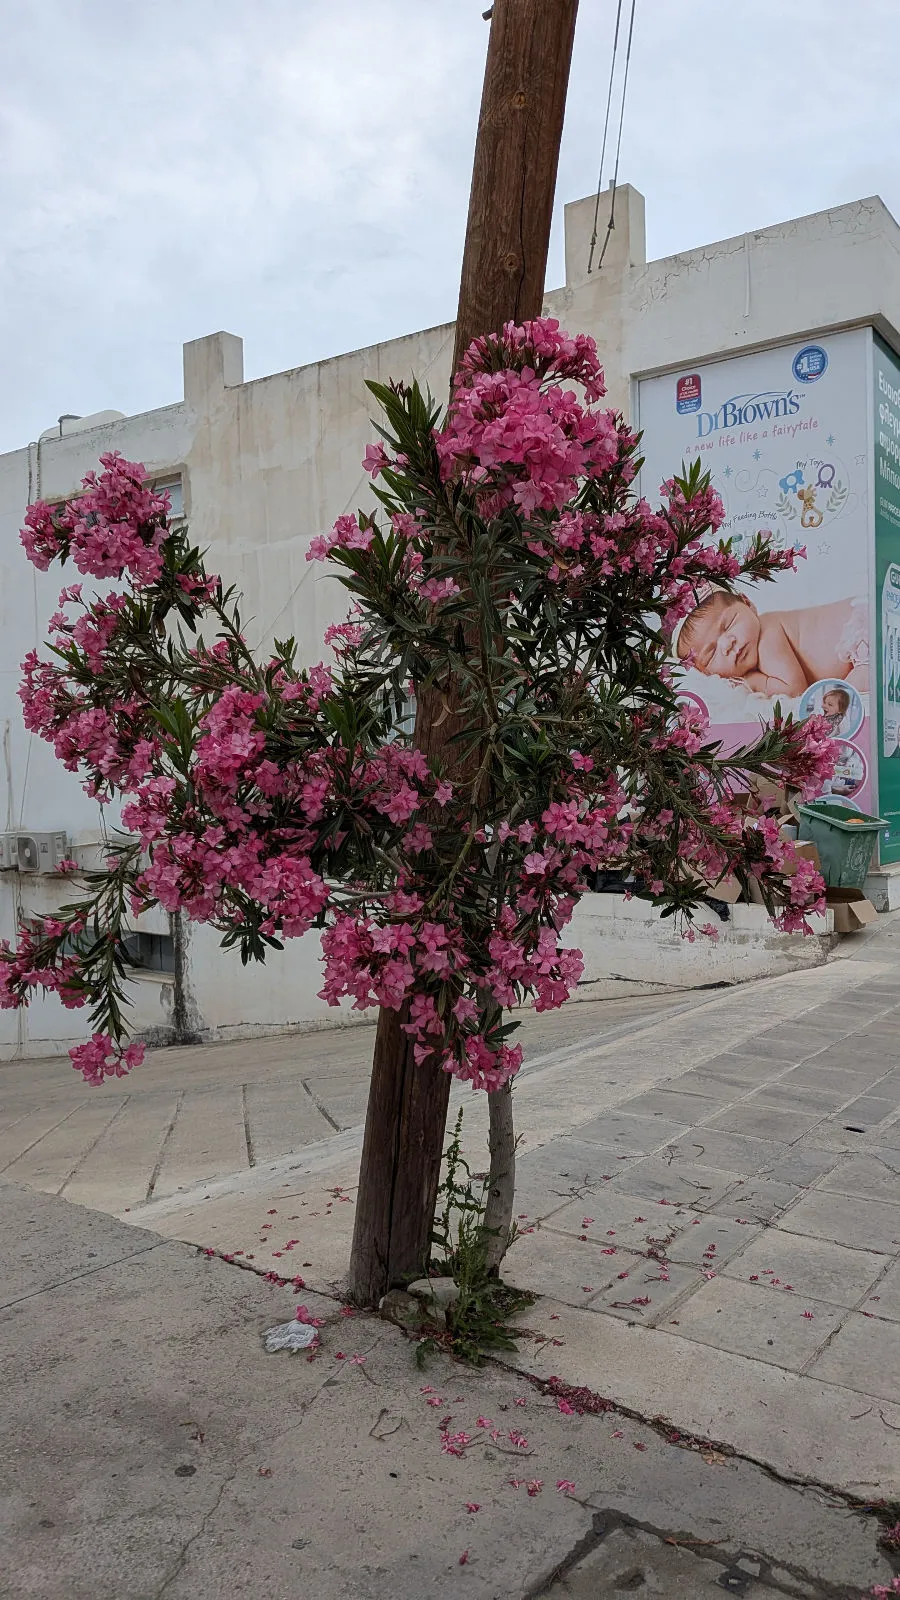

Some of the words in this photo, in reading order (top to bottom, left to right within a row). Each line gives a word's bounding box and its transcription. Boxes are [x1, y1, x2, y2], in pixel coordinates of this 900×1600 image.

[685, 446, 691, 454] a
[694, 442, 714, 452] new
[718, 436, 735, 448] life
[740, 431, 758, 444] like
[762, 430, 768, 438] a
[772, 418, 818, 438] fairytale
[796, 460, 807, 470] My
[809, 458, 824, 468] Toys
